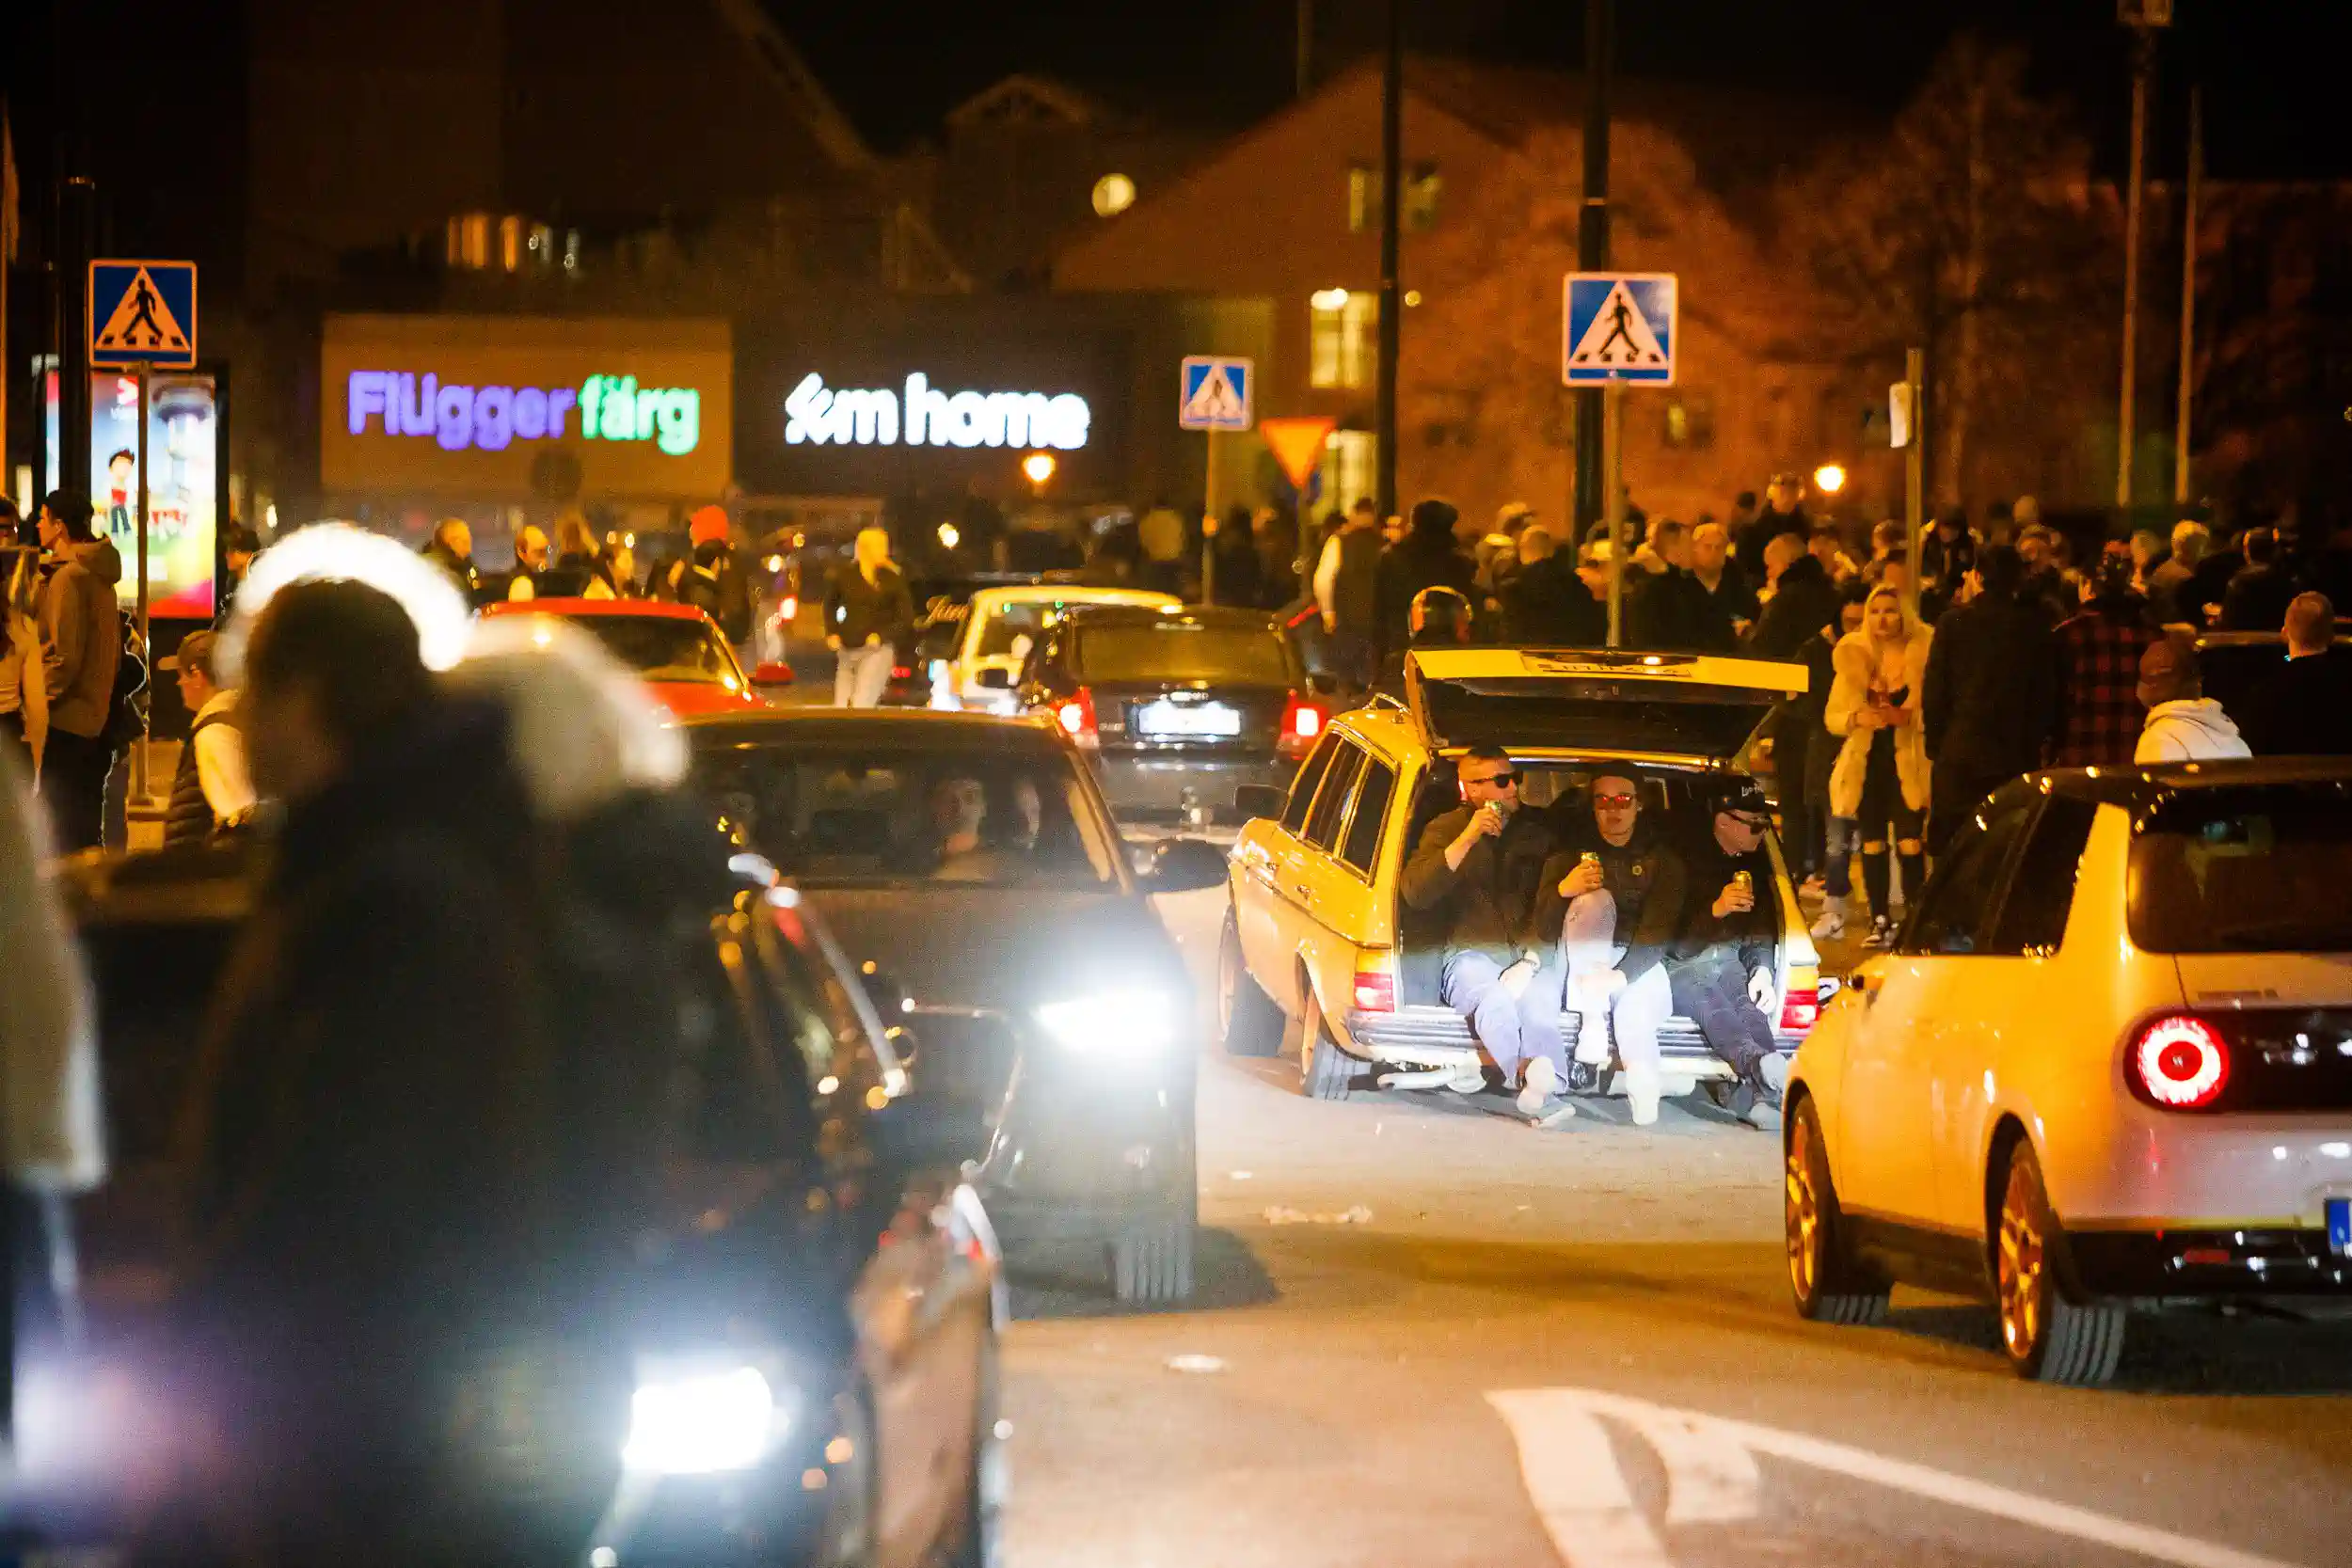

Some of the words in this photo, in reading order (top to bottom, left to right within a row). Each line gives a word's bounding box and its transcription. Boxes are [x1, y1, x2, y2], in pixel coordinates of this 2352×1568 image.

[348, 371, 576, 450] Flügger
[578, 374, 699, 454] färg
[905, 372, 1089, 449] home
